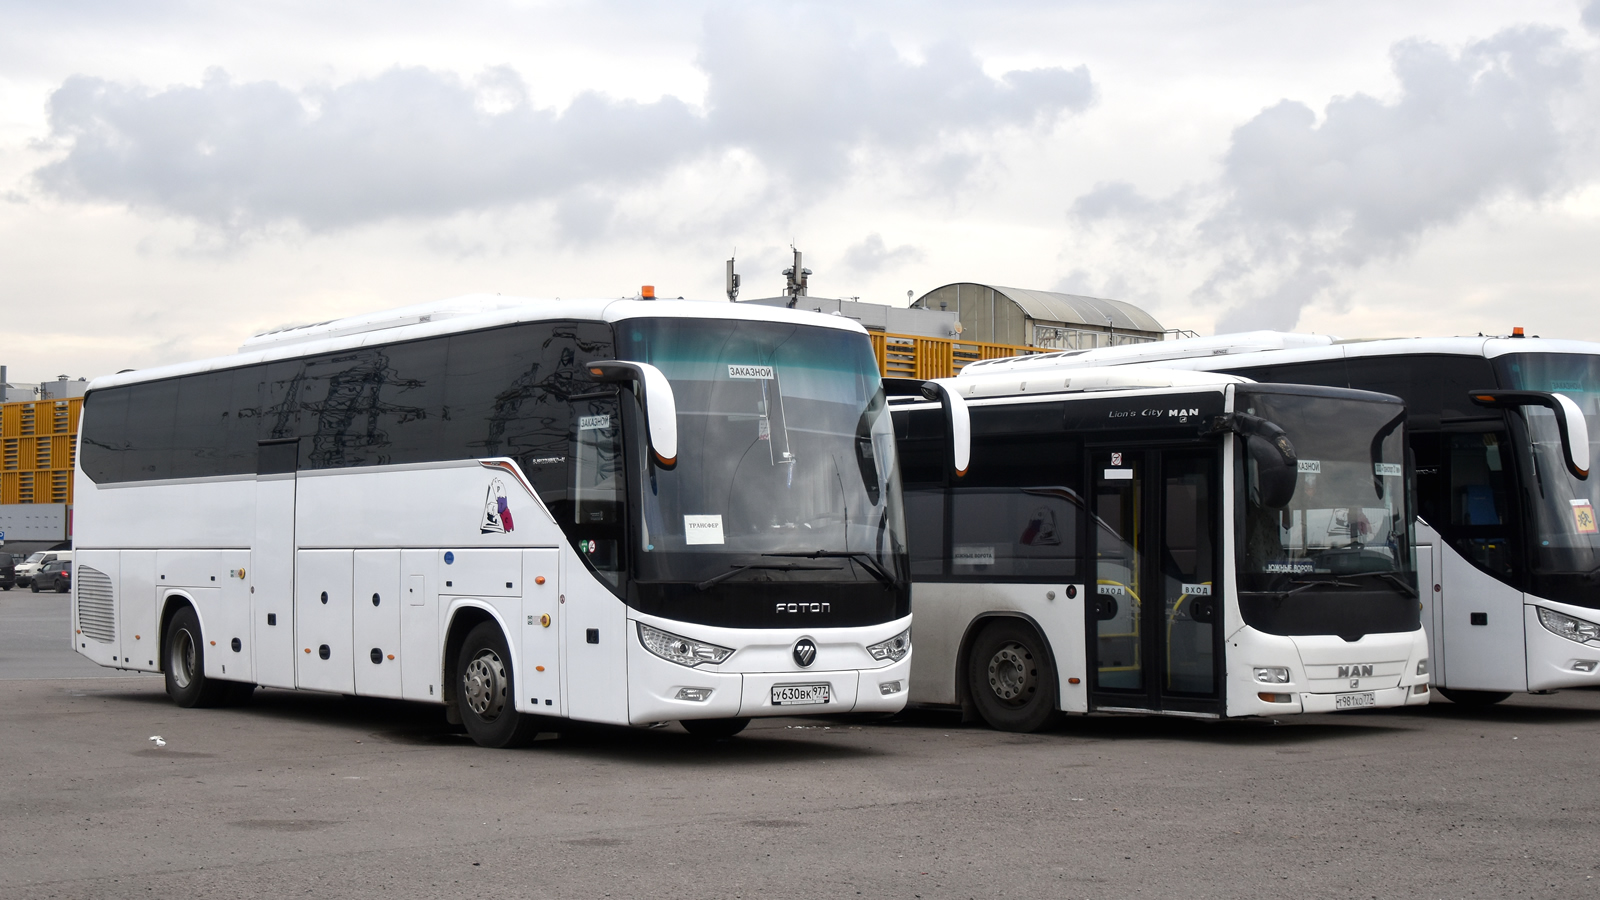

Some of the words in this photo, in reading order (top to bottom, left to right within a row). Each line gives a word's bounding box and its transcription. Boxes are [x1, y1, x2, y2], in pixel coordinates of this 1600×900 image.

[730, 366, 772, 377] ЗАКАЗНОЙ
[1108, 410, 1136, 418] Lion's
[1141, 409, 1163, 417] City
[1168, 408, 1199, 417] MAN
[581, 416, 608, 428] ЗАКАЗНОЙ
[1298, 462, 1320, 471] КАЗНОЙ
[1101, 587, 1122, 595] ВХОД
[1185, 586, 1208, 594] ВХОД
[776, 603, 831, 613] FOTON
[1338, 664, 1373, 678] MAN
[813, 686, 827, 696] 977
